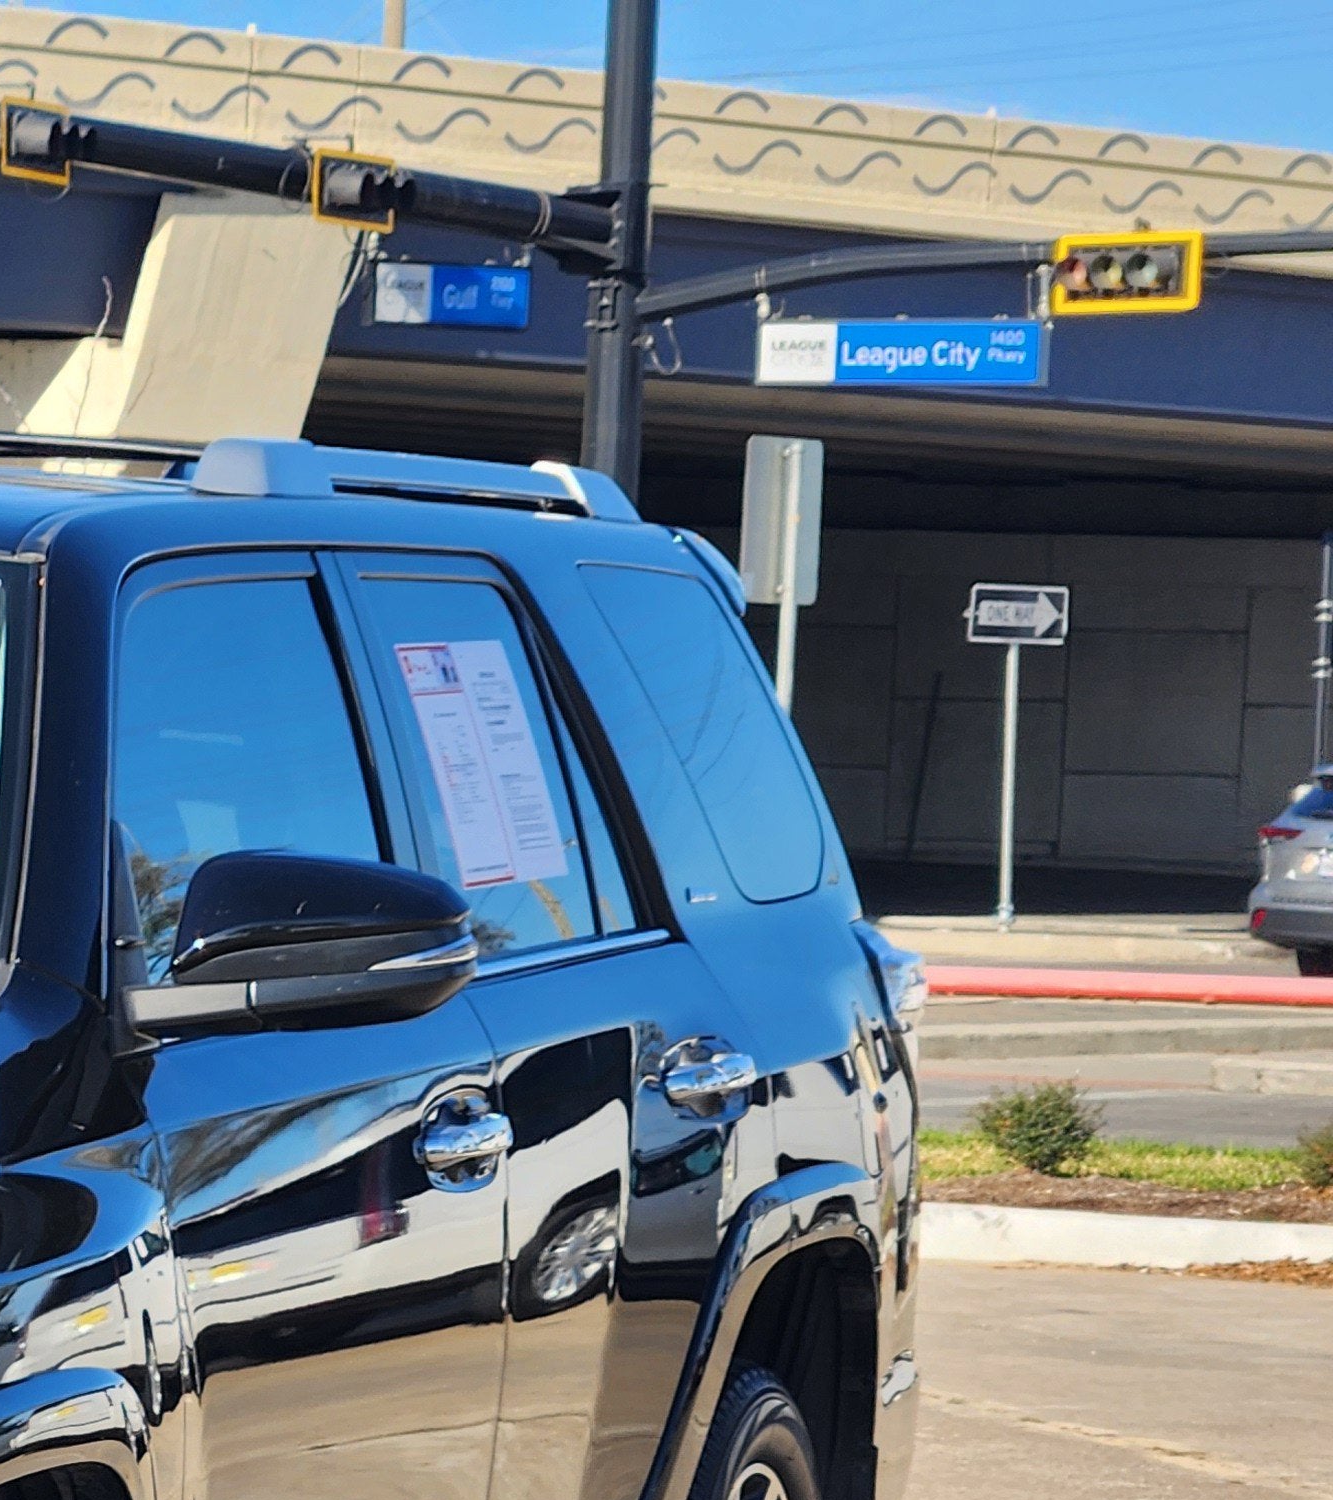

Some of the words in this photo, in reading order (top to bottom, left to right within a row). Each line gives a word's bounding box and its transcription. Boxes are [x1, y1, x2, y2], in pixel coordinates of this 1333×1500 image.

[442, 284, 480, 310] Gulf
[771, 339, 827, 351] LEAGUE
[840, 341, 928, 373] League
[931, 341, 981, 372] City
[987, 604, 1010, 622] ONE
[1013, 604, 1036, 622] WAY
